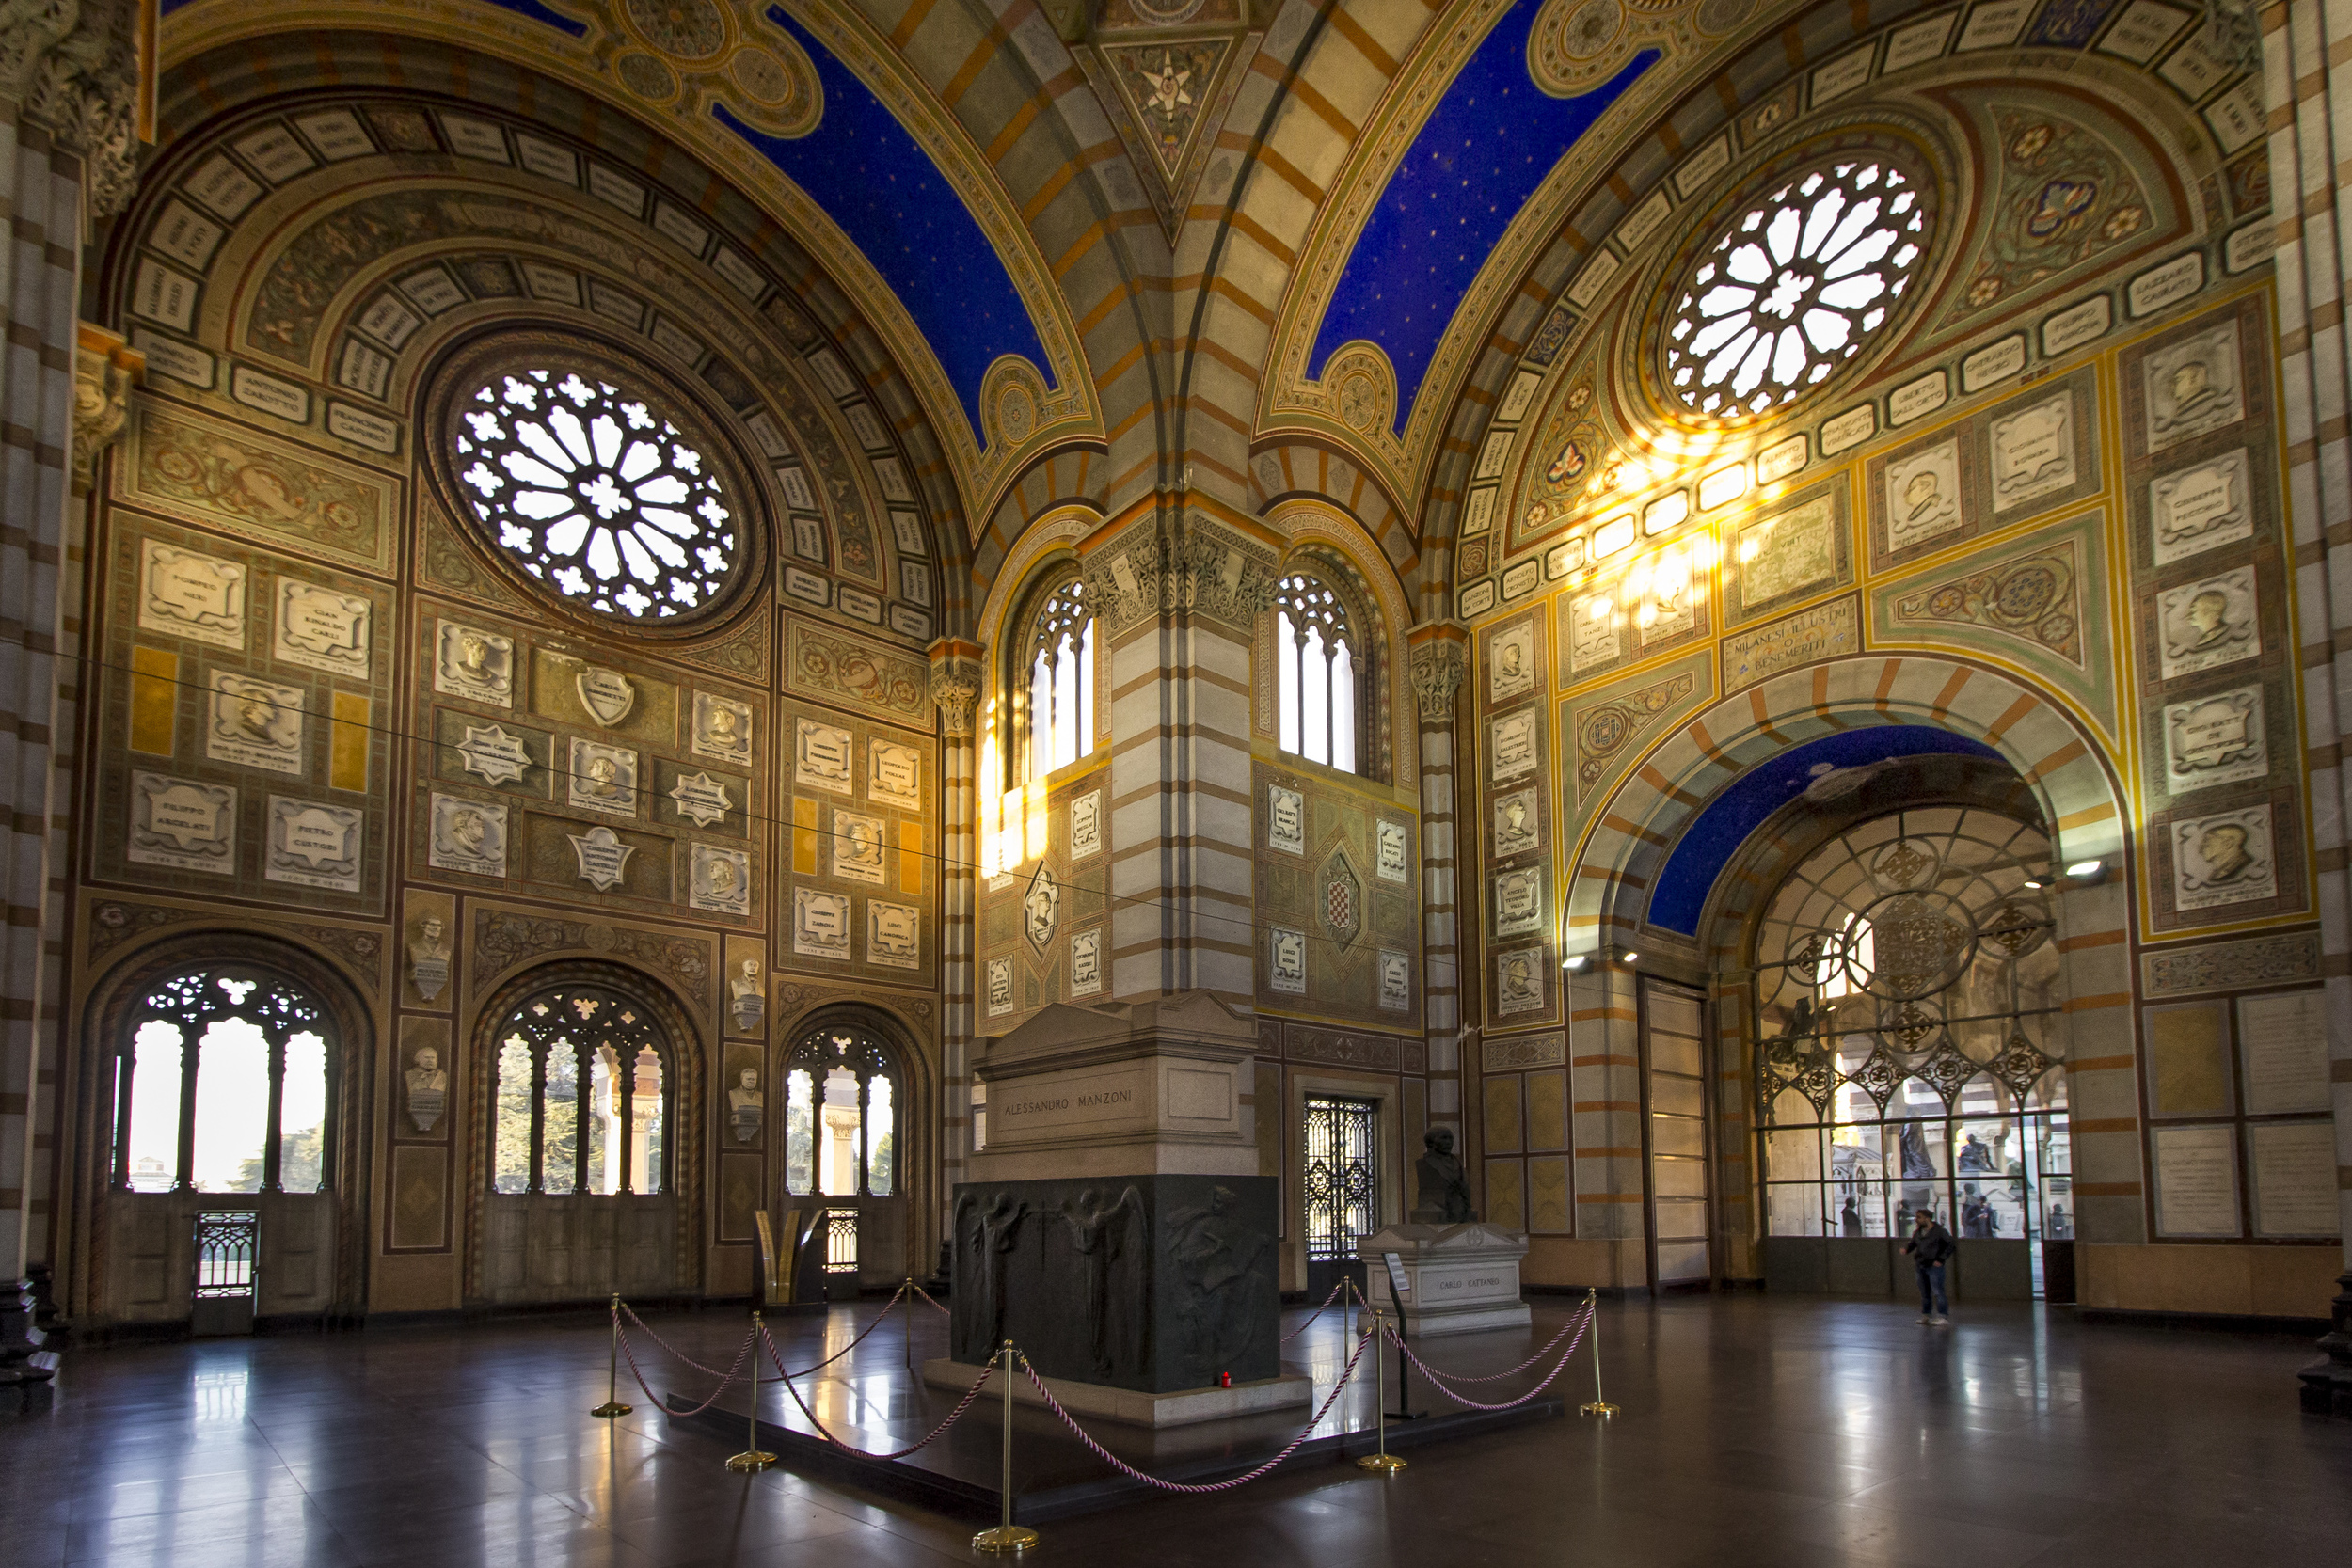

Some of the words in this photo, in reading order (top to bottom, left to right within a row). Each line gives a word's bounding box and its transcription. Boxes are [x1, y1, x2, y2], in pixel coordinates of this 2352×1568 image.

[245, 375, 299, 402] ANTONIO
[2173, 485, 2222, 509] GIUSEPPE
[2174, 500, 2225, 522] PECCHIO
[172, 574, 217, 591] POMPEO
[1505, 567, 1534, 584] ARNOLFO
[1505, 577, 1535, 594] CRONISTA
[1464, 586, 1490, 603] LANZONE
[1471, 594, 1491, 609] CORTE
[314, 609, 339, 620] GIAN
[304, 615, 347, 632] RINALDO
[1583, 626, 1604, 637] TANZI
[1734, 627, 1785, 654] MILANESI
[1792, 607, 1846, 635] ILLUSTRI
[1784, 637, 1794, 648] O
[1754, 639, 1826, 671] BENEMERITI
[1500, 732, 1527, 744] DOMENICO
[882, 760, 910, 771] LEOPOLDO
[1005, 1098, 1069, 1116] ALESSANDRO
[1078, 1089, 1132, 1108] MANZONI
[1439, 1279, 1462, 1290] CARLO
[1468, 1276, 1500, 1288] CATTANEO
